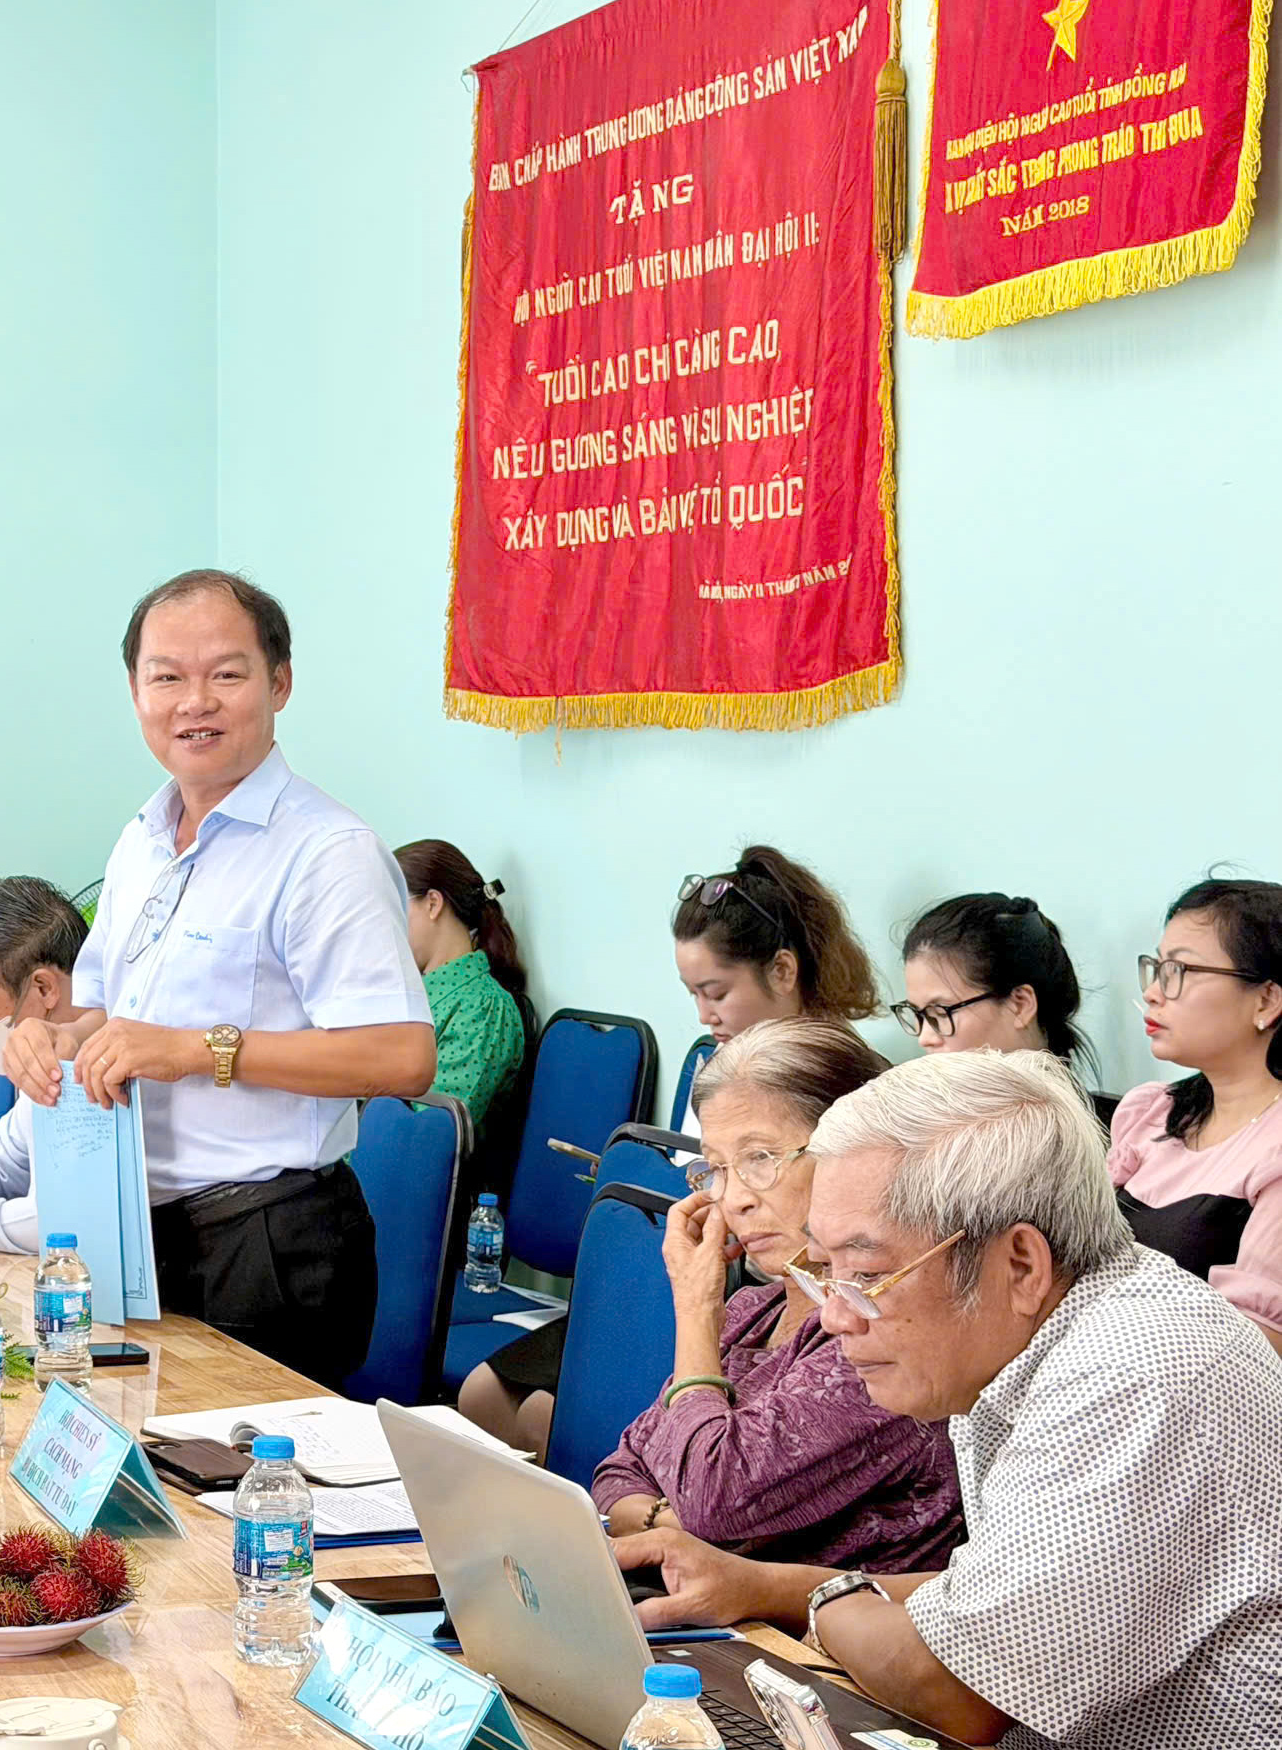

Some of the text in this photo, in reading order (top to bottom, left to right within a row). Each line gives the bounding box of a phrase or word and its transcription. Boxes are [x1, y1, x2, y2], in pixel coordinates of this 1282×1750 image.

[514, 140, 543, 186] CHẤP
[546, 131, 582, 173] HÀNH
[584, 115, 627, 158] TRUNG
[704, 71, 749, 118] CỘNG
[753, 54, 787, 100] SẢN
[790, 36, 831, 85] VIỆT
[998, 112, 1019, 145] HỘI
[1049, 97, 1072, 125] CAO
[987, 155, 1017, 198] SẮC
[1139, 118, 1167, 154] THI
[1168, 106, 1203, 147] ĐUA
[609, 174, 694, 226] TẶNG
[1048, 195, 1090, 221] 2018
[605, 253, 634, 298] TUỔI
[638, 248, 668, 291] VIỆT
[670, 244, 703, 280] NAM
[741, 226, 770, 268] ĐẠI
[774, 211, 799, 259] HỘI
[591, 353, 630, 396] CAO
[635, 333, 670, 385] CHÍ
[674, 328, 720, 377] CÀNG
[493, 437, 545, 480] NÊU
[551, 429, 617, 473] GƯƠNG
[622, 412, 678, 462] SÁNG
[681, 406, 698, 450] VÌ
[700, 403, 721, 451] SỰ
[502, 507, 547, 550] XÂY
[556, 506, 609, 551] DỰNG
[612, 495, 635, 539] VÀ
[700, 471, 721, 525] TỔ
[724, 580, 753, 599] NGÀY
[803, 565, 836, 587] NĂM
[347, 1636, 382, 1672] HỘI
[414, 1678, 457, 1716] BÁO
